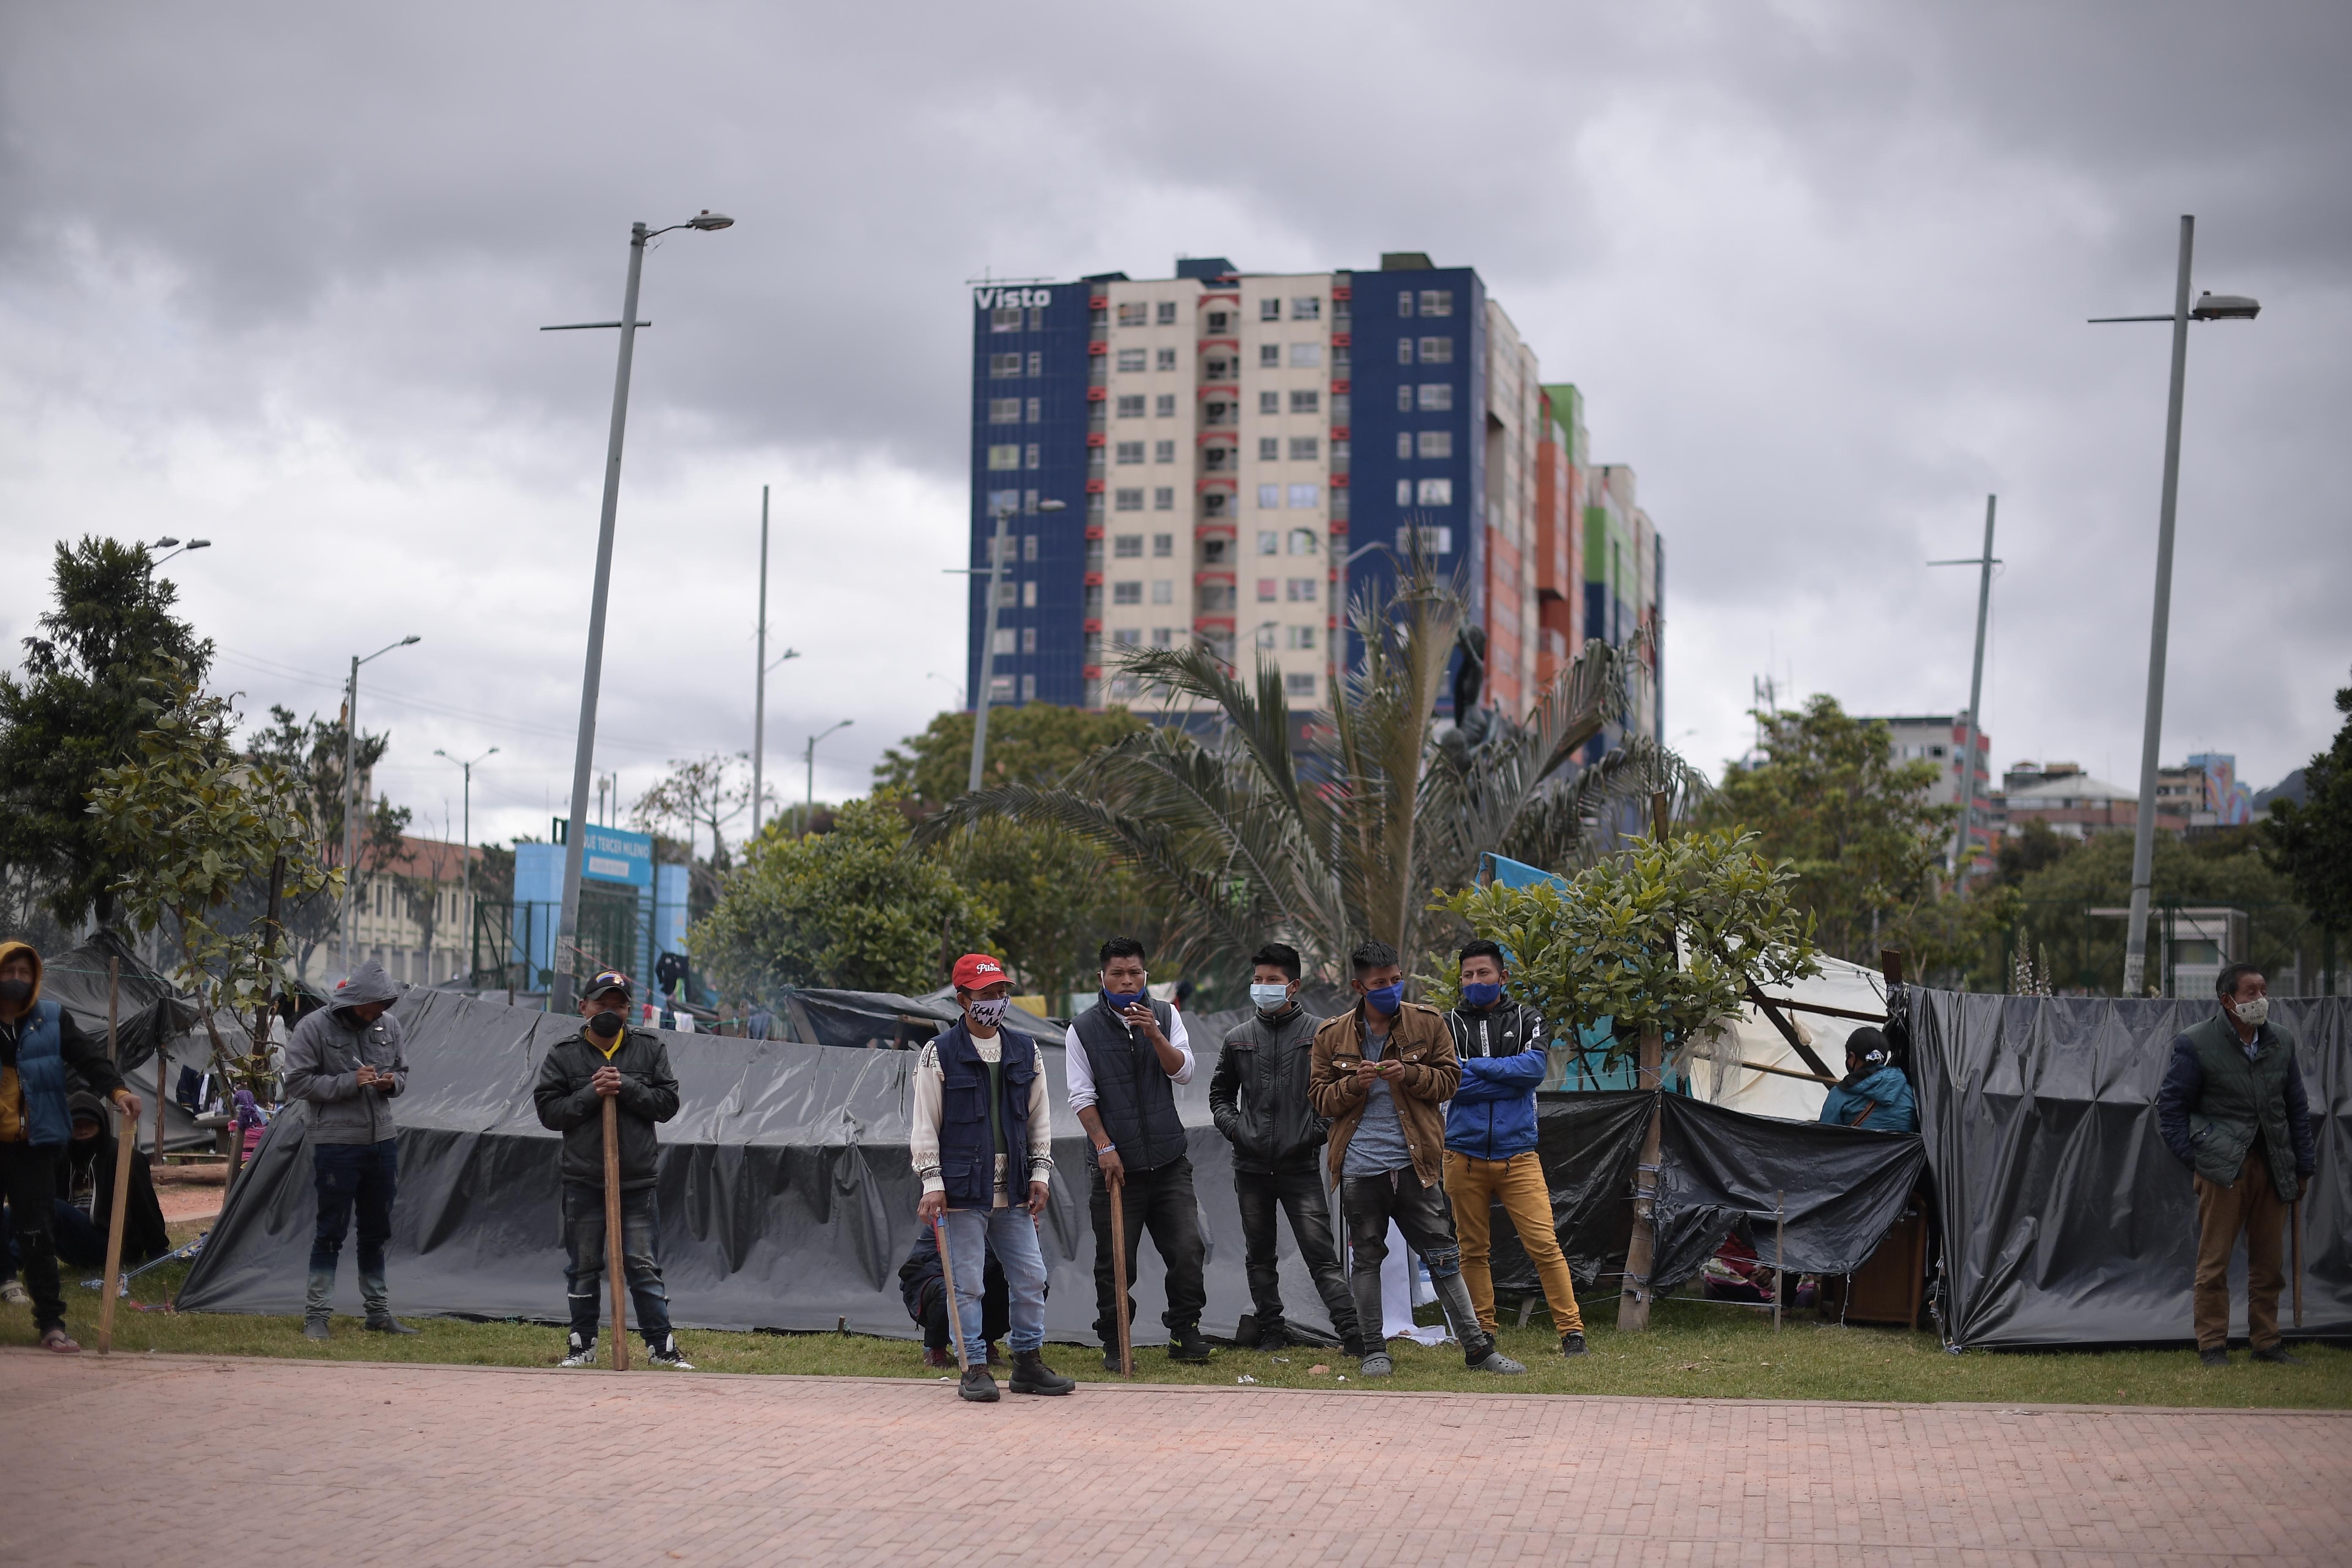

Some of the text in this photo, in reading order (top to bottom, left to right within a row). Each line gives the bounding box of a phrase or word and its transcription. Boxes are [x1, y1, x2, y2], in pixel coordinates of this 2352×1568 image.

[975, 289, 1051, 310] Visto
[976, 963, 1001, 974] Pilsen
[971, 1004, 995, 1021] REAL
